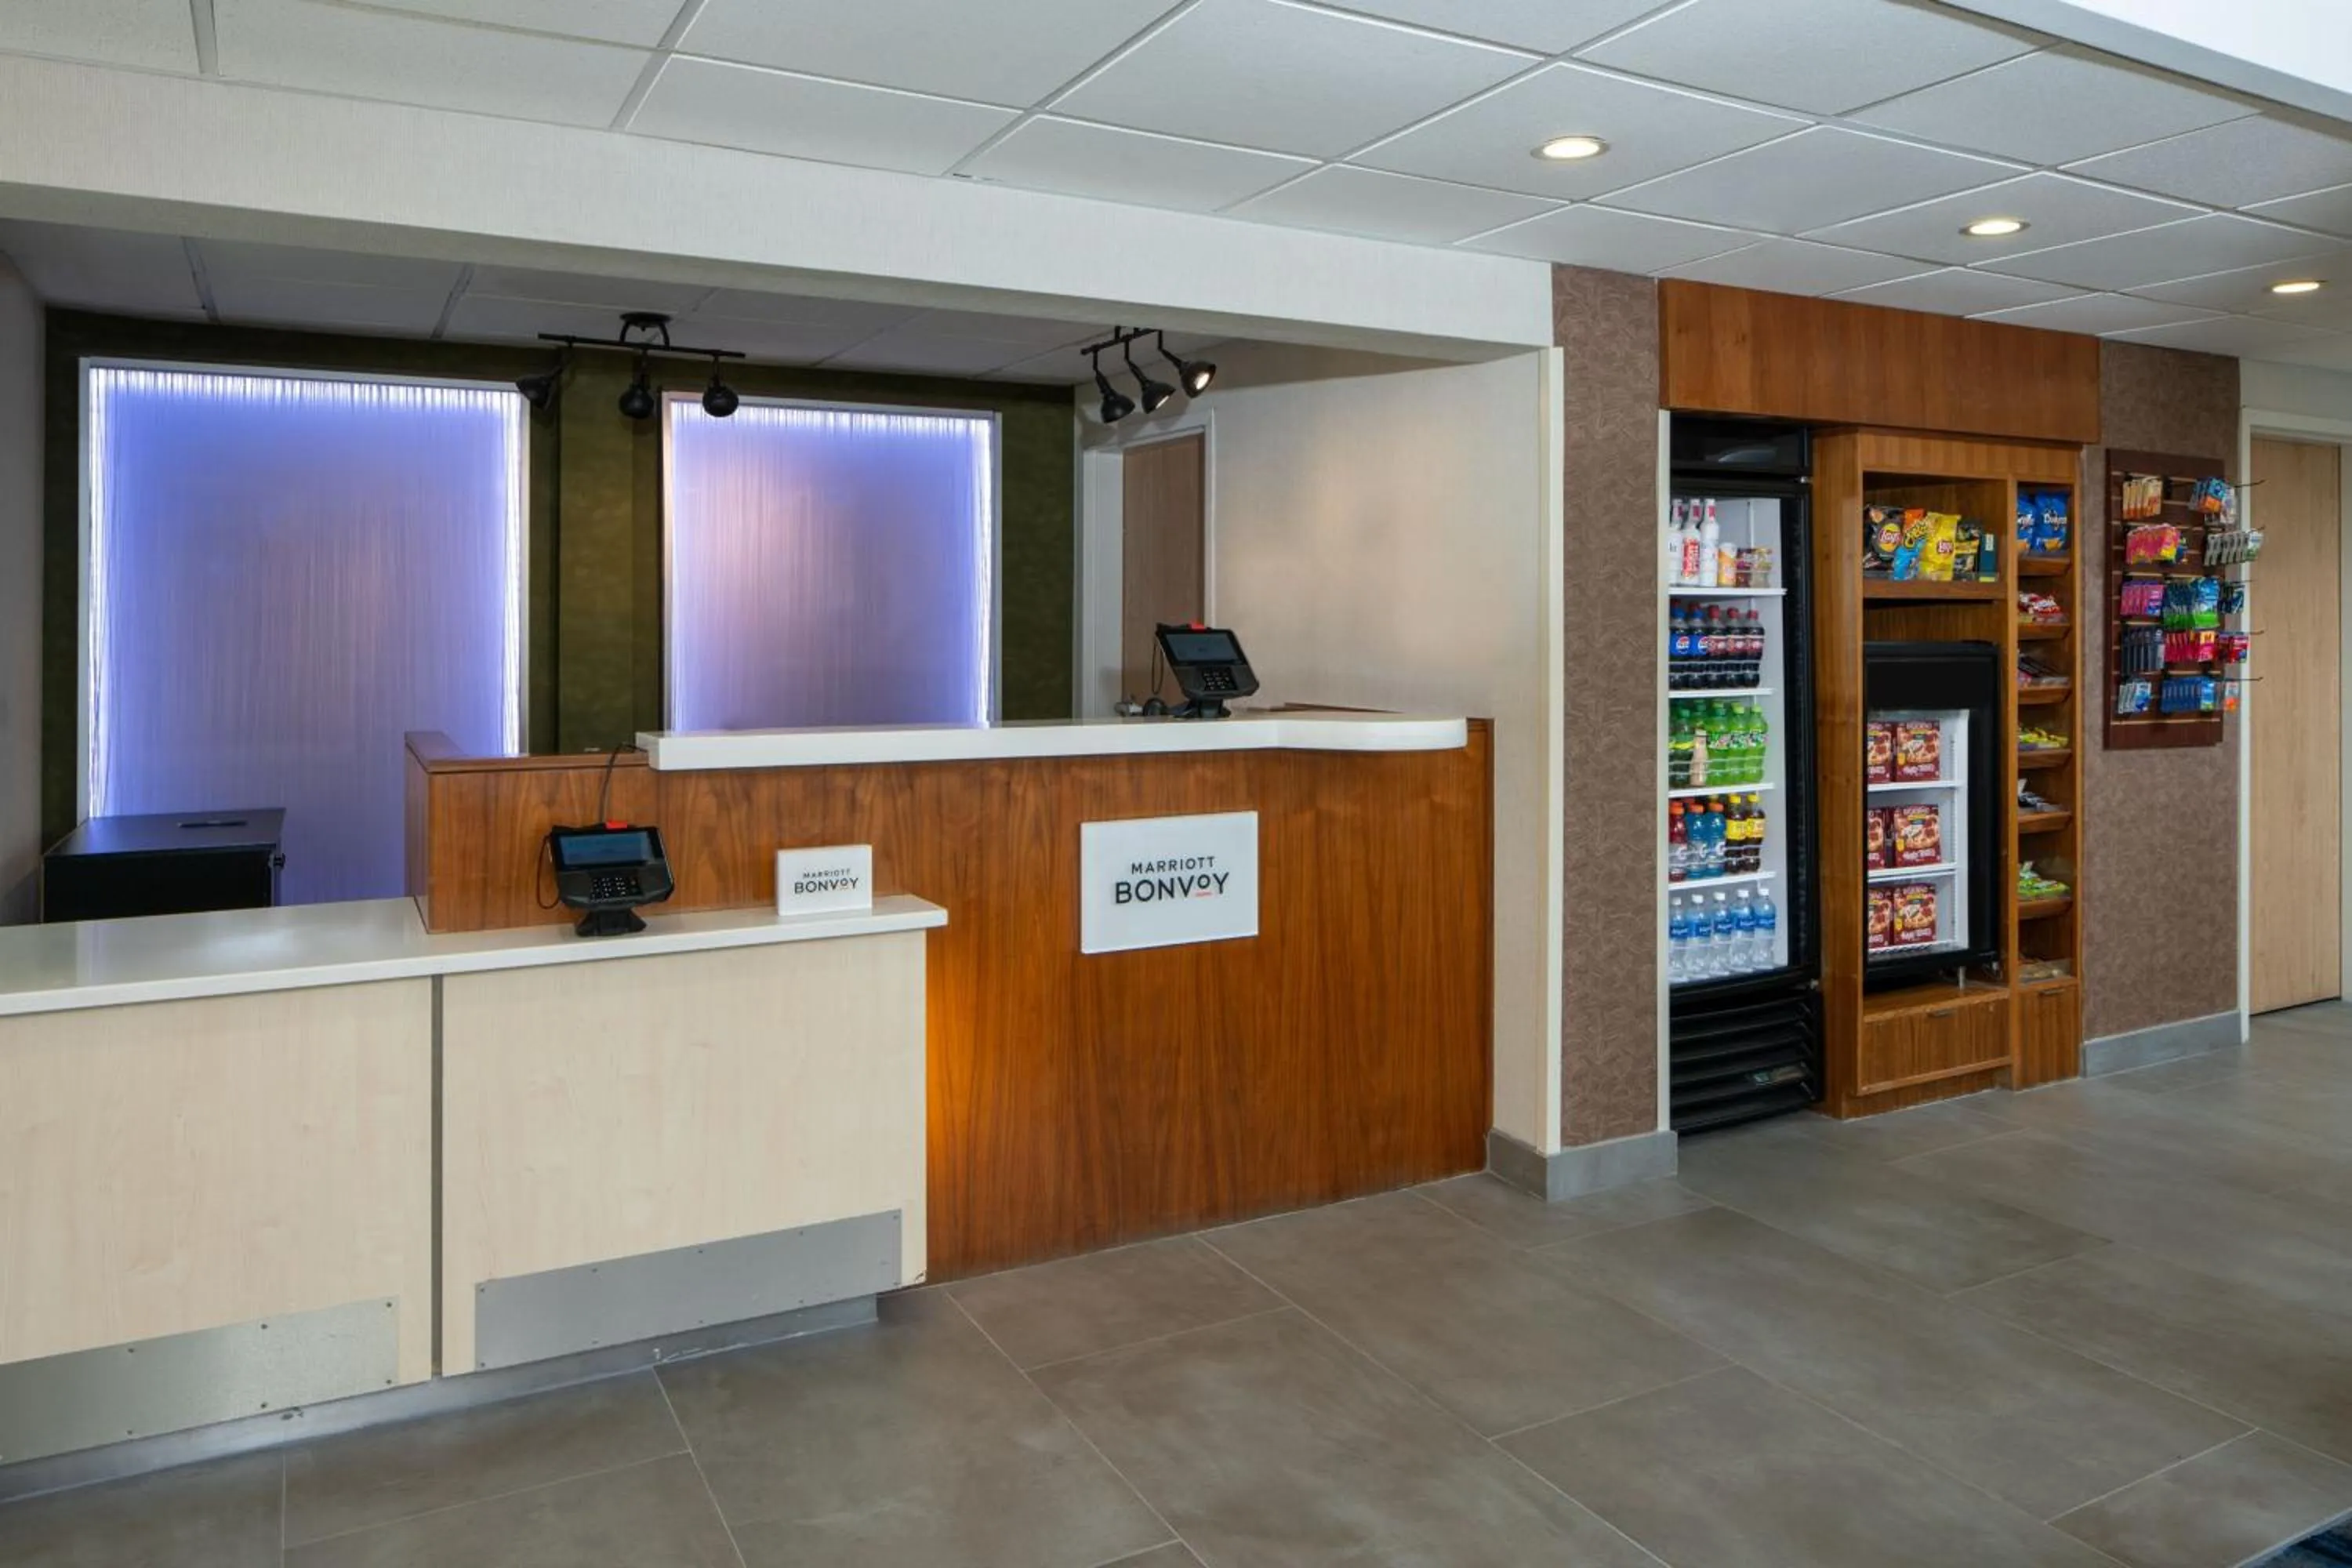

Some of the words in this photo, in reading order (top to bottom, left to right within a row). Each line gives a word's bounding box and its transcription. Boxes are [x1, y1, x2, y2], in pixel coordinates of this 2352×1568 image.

[803, 868, 851, 879] MARRIOTT
[1131, 856, 1215, 875] MARRIOTT
[794, 877, 859, 895] BONVOY
[1115, 872, 1229, 905] BONVOY
